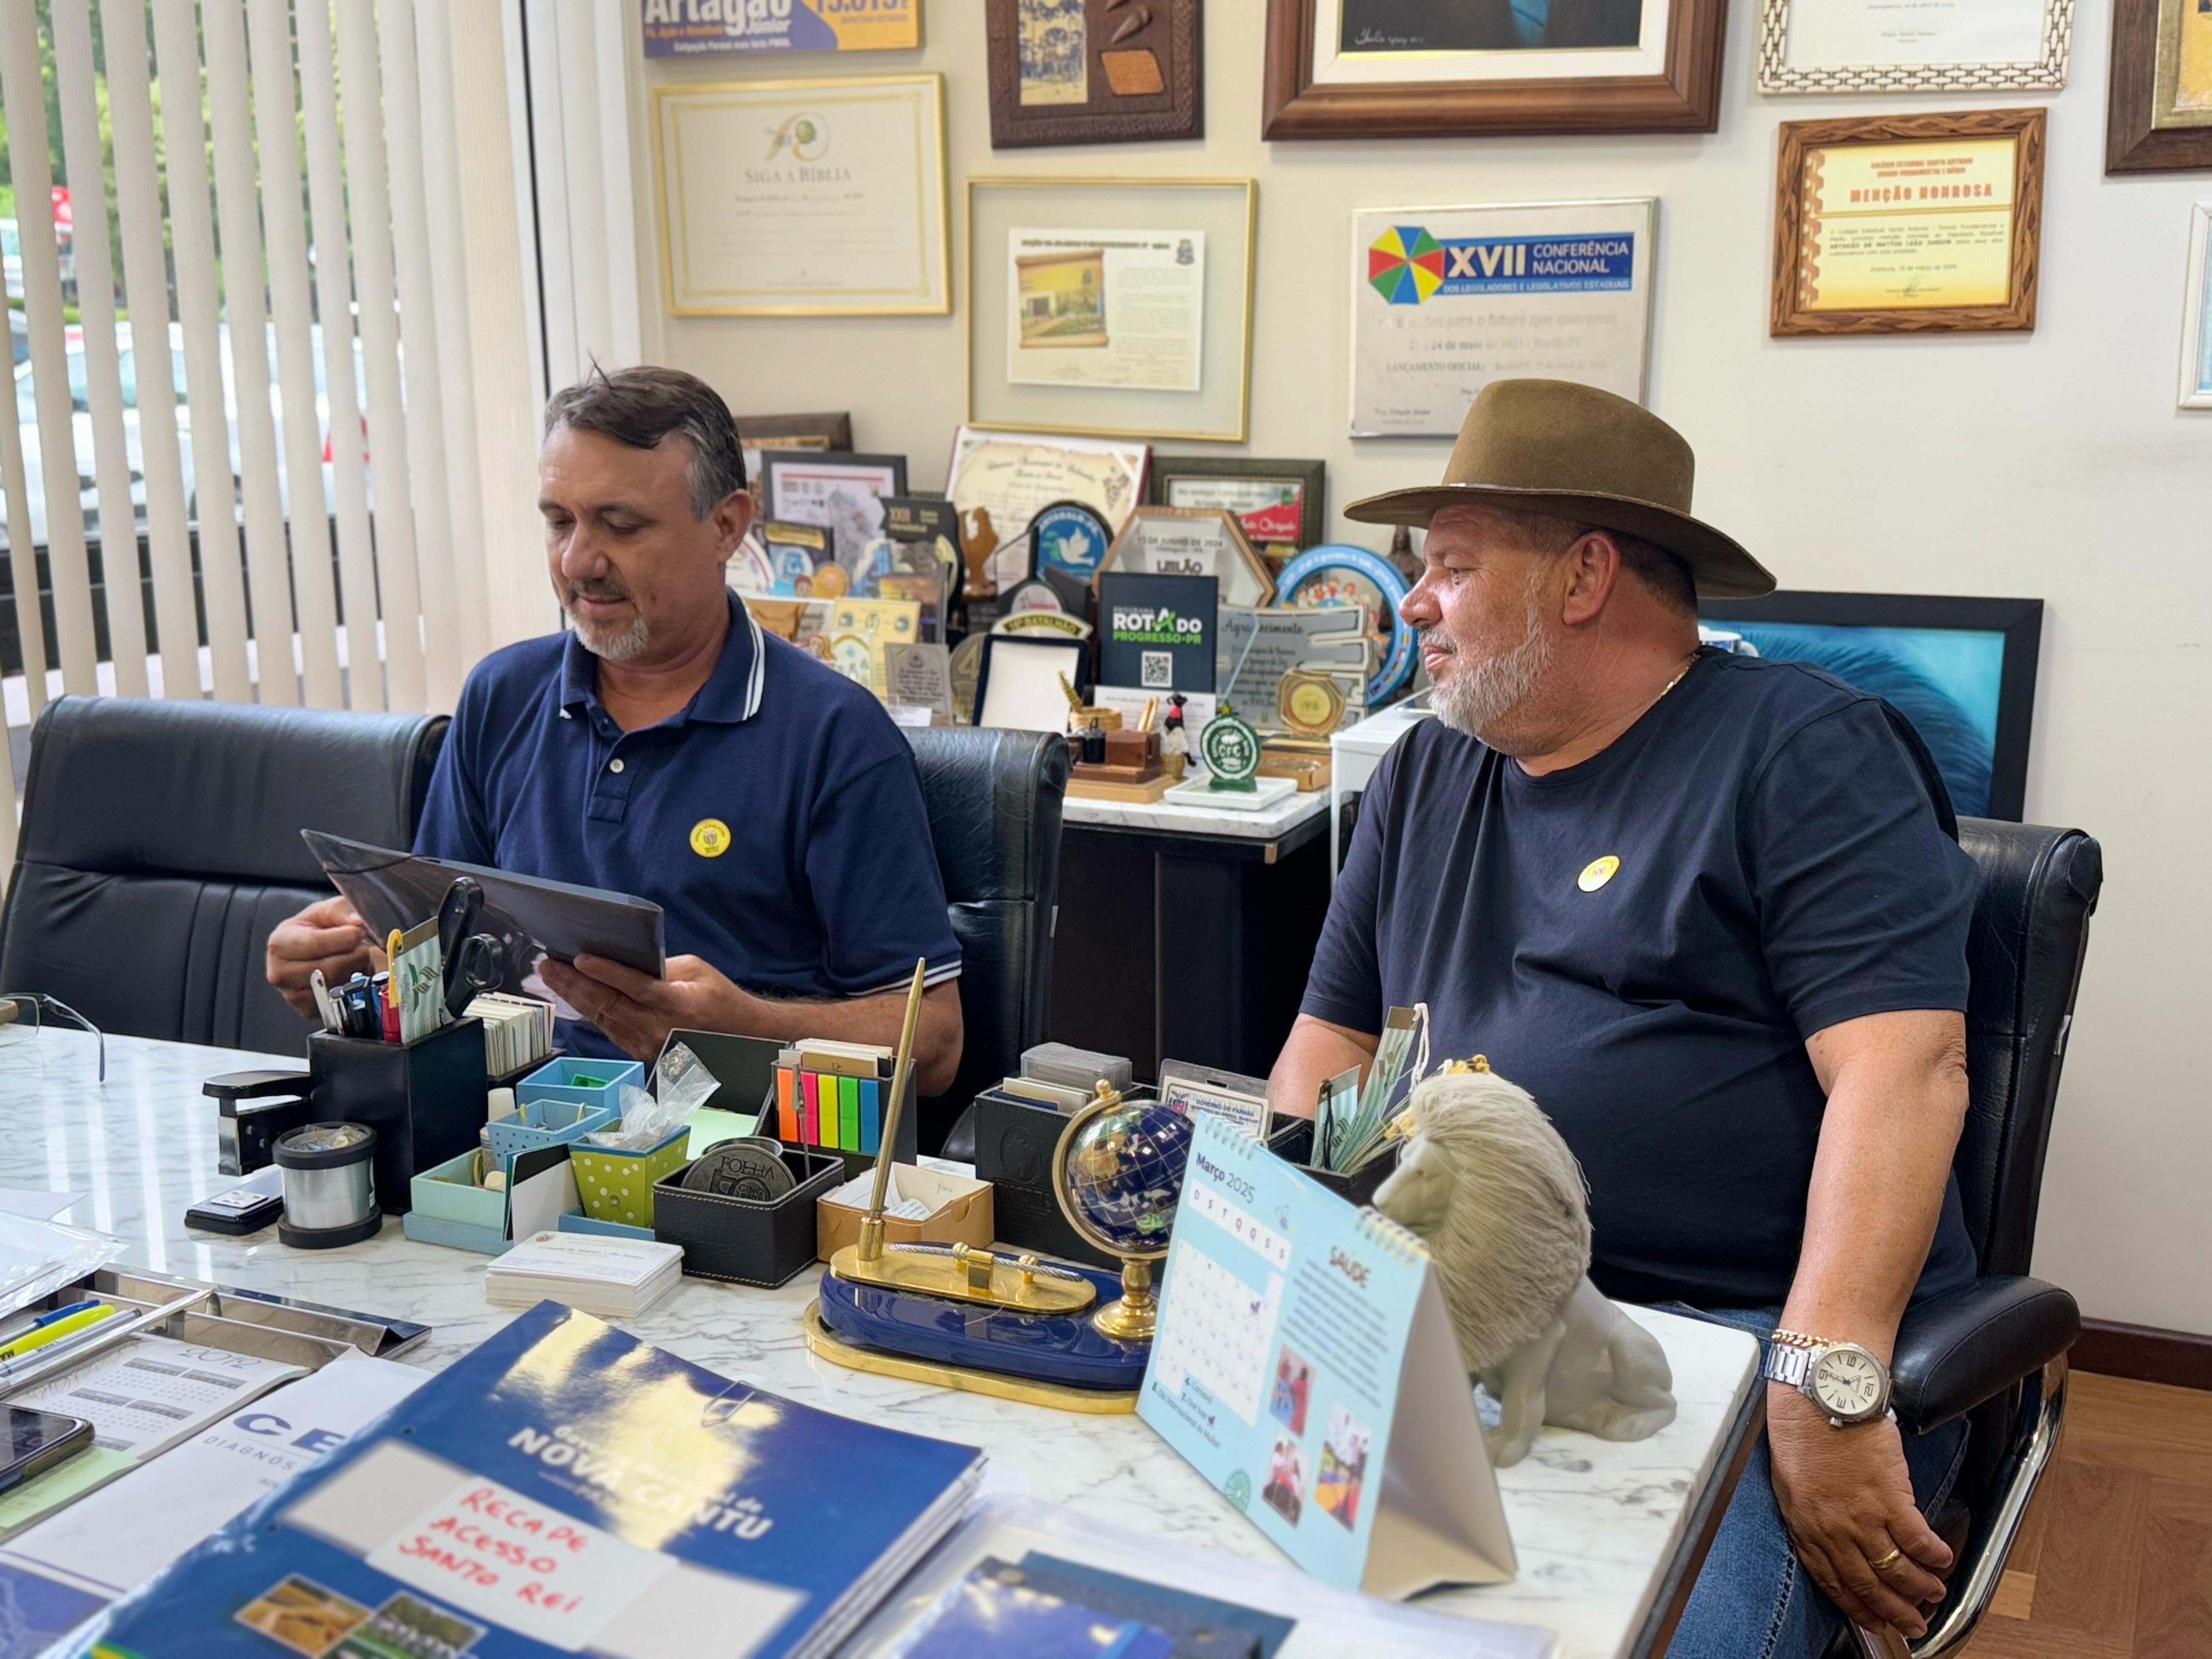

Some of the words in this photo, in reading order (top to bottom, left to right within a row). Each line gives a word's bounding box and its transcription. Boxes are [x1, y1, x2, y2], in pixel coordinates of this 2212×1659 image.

[1850, 185, 1912, 204] MENÇÃO
[1920, 183, 1993, 200] HONROSA
[1532, 240, 1629, 258] CONFERÊNCIA
[1447, 245, 1526, 278] XVII
[1532, 258, 1610, 274] NACIONAL
[1443, 284, 1459, 293] DOS
[1461, 283, 1517, 292] LEGISLADORES
[1176, 618, 1203, 634] DO
[1218, 744, 1242, 758] CFC
[721, 1155, 775, 1181] FOLHA
[1196, 1152, 1225, 1182] Março
[1226, 1172, 1255, 1204] 2025
[1194, 1189, 1200, 1200] D
[1207, 1199, 1214, 1210] S
[1222, 1207, 1228, 1218] T
[1235, 1217, 1242, 1232] Q
[1250, 1228, 1256, 1242] Q
[1265, 1238, 1271, 1249] S
[1279, 1248, 1285, 1260] S
[177, 1347, 262, 1370] 2012
[507, 1426, 623, 1491] NOVA
[429, 1516, 557, 1574] ACESSO
[398, 1535, 499, 1586] SANTO
